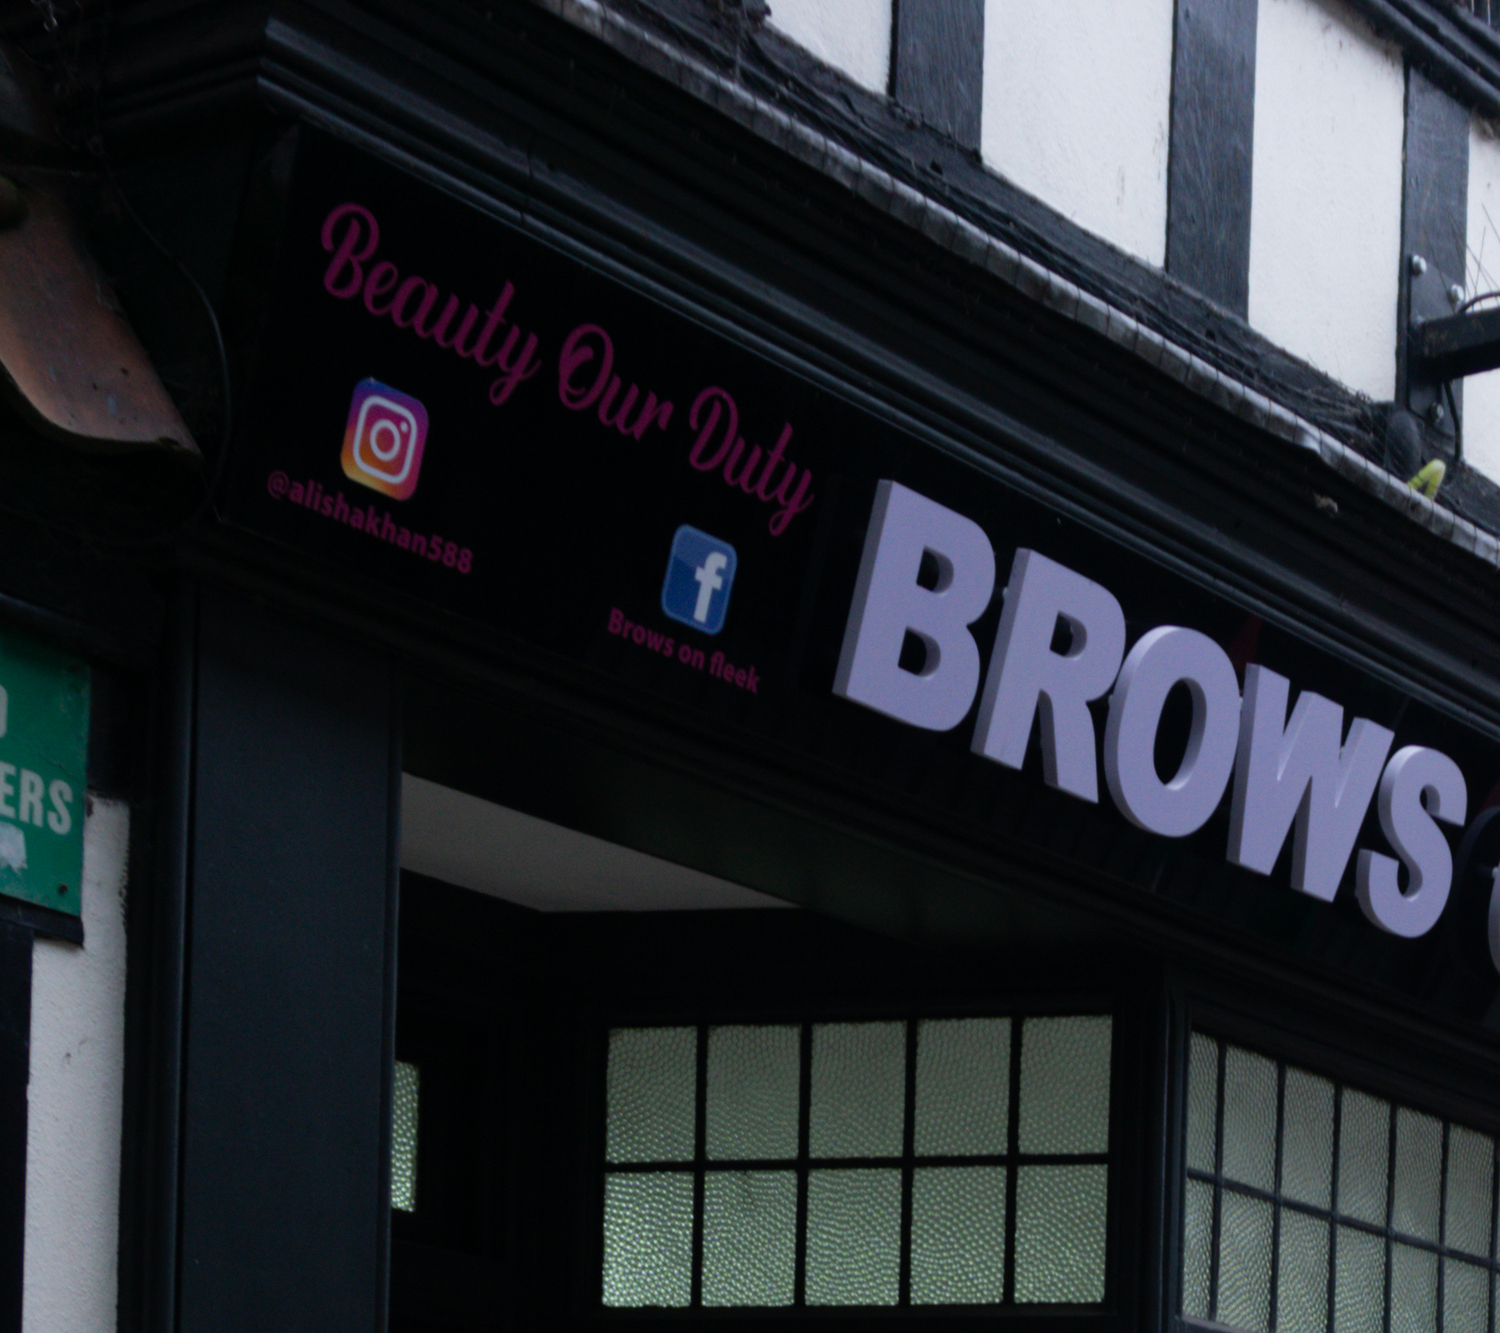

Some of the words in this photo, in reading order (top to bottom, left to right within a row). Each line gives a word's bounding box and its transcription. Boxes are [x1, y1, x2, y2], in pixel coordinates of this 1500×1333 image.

[321, 202, 542, 406] Beauty
[558, 322, 673, 442] Our
[688, 386, 816, 536] Duty
[266, 470, 474, 575] @alishakhan588
[607, 608, 674, 661] Brows
[678, 640, 708, 674] on
[709, 649, 760, 694] fleek
[833, 479, 1467, 938] BROWS
